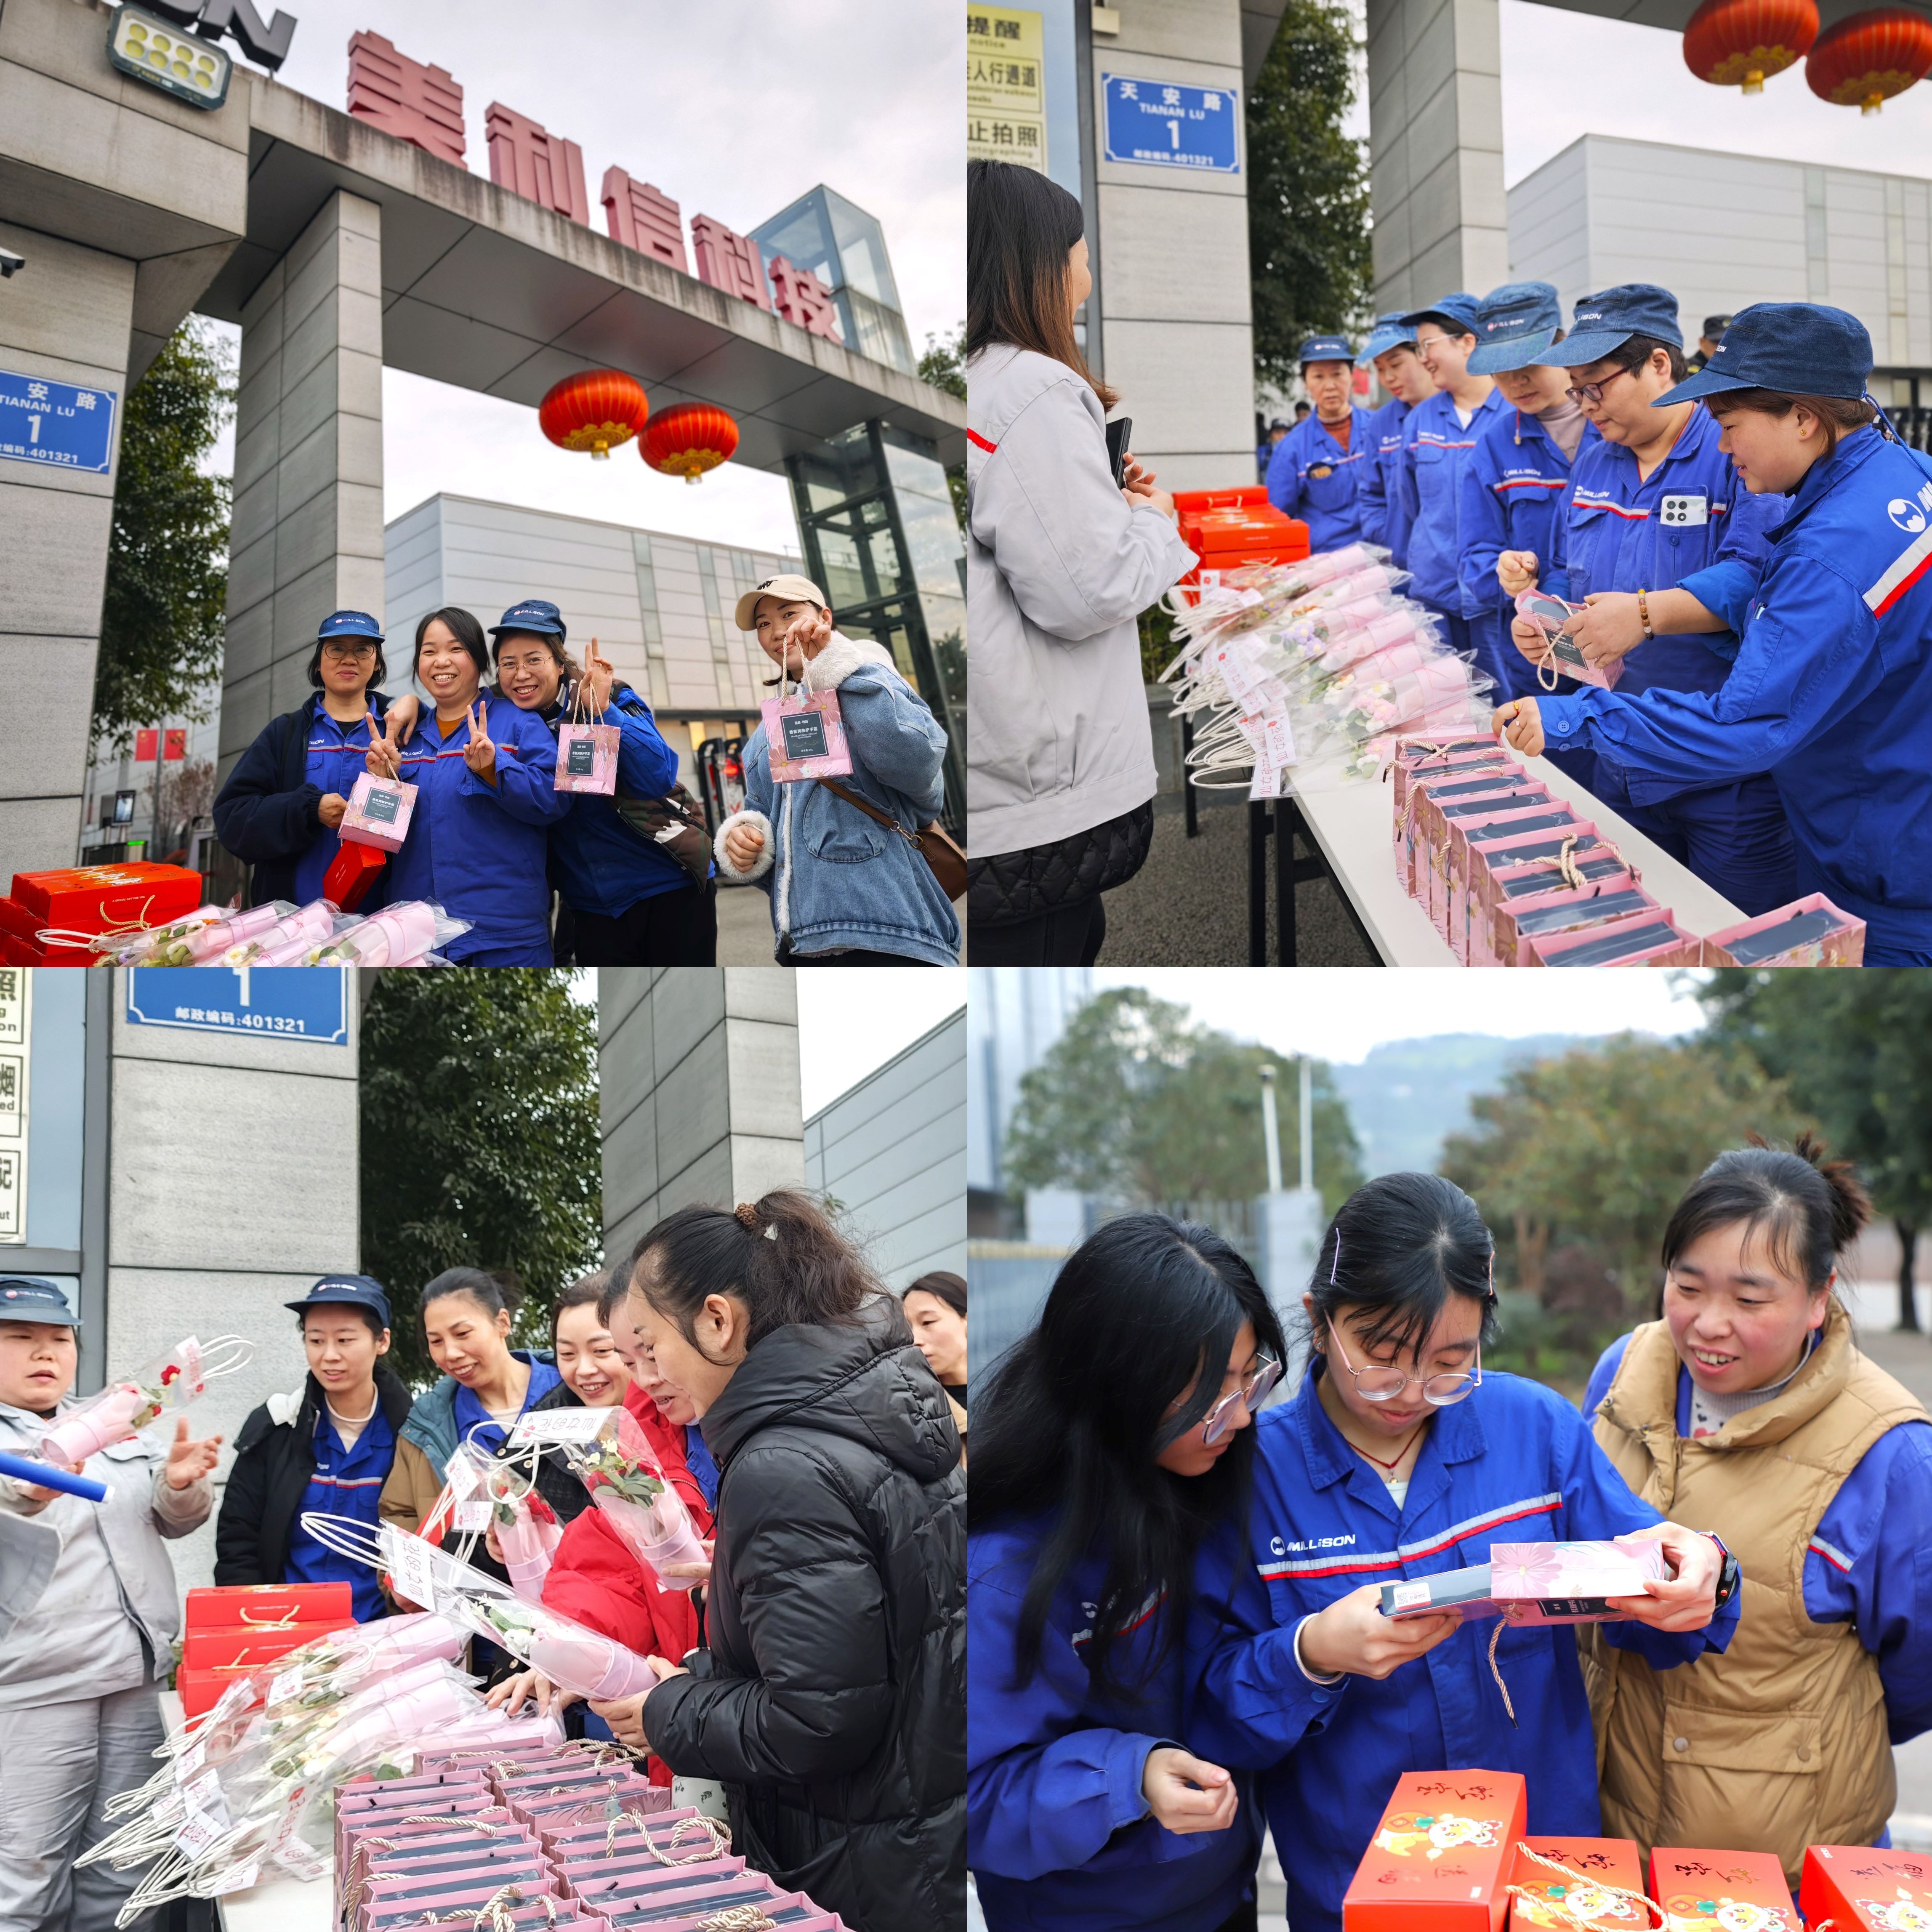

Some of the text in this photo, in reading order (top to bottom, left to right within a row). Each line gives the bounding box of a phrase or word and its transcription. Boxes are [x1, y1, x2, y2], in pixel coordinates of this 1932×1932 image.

[967, 59, 1035, 87] 人行通道
[1119, 82, 1221, 112] 天安路
[1139, 102, 1206, 120] TIANAN LU
[1166, 120, 1179, 149] 1
[347, 29, 844, 344] 美利信科技
[57, 405, 75, 417] LU
[28, 415, 41, 443] 1
[0, 443, 78, 463] 编码:401321
[1269, 723, 1289, 763] 仙女的花
[233, 967, 250, 1006] 1
[175, 1006, 305, 1033] 邮政编码:401321
[402, 1540, 425, 1599] 仙女的花
